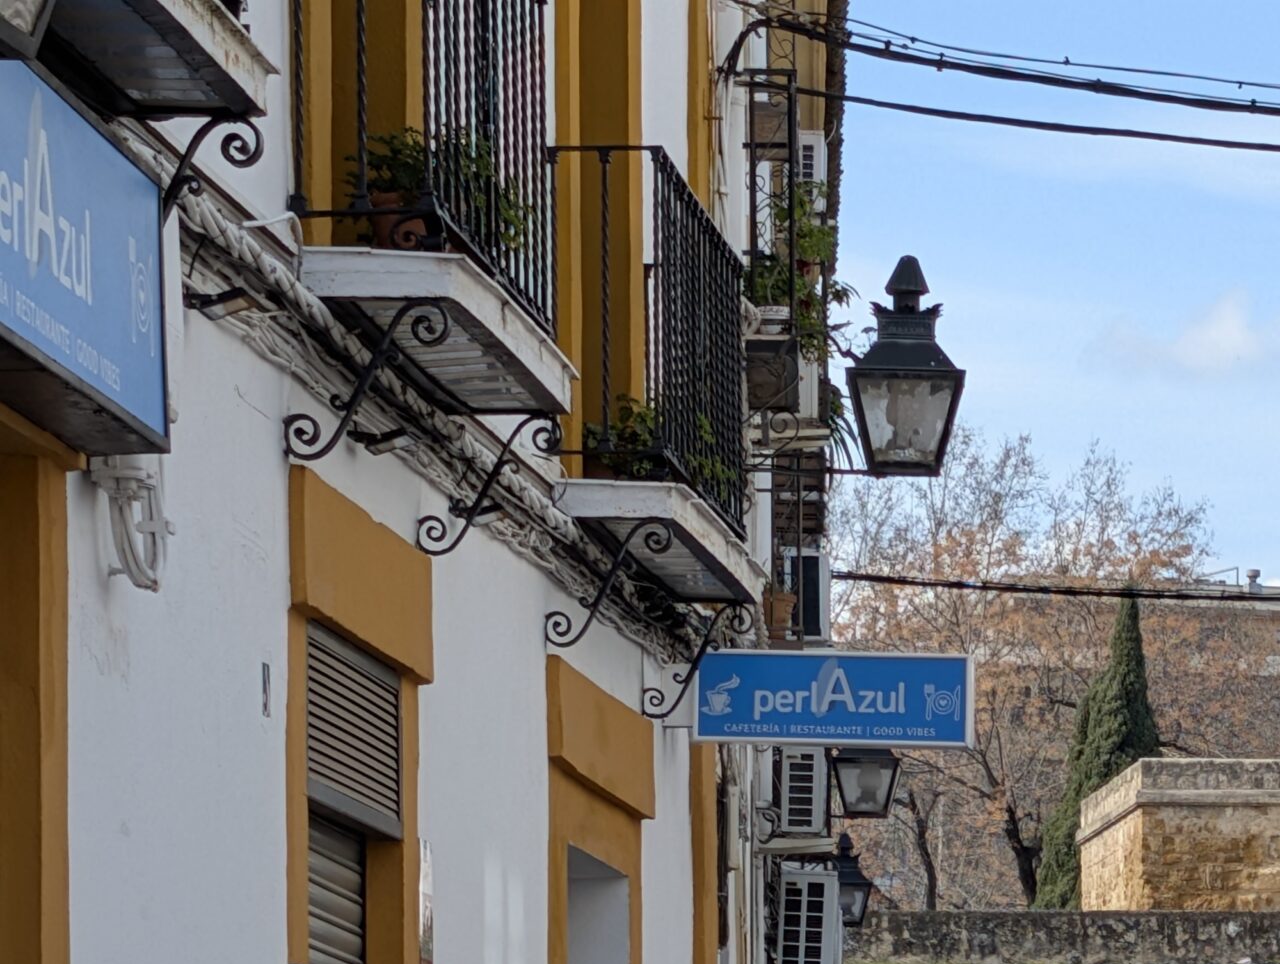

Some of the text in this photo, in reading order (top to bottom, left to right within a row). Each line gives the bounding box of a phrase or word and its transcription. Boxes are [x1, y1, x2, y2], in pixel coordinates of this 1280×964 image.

[16, 290, 70, 354] RESTAURANTE
[754, 668, 905, 720] perlAzul
[724, 722, 936, 737] CAFETERÍA RESTAURANTE GOOD VIBES
